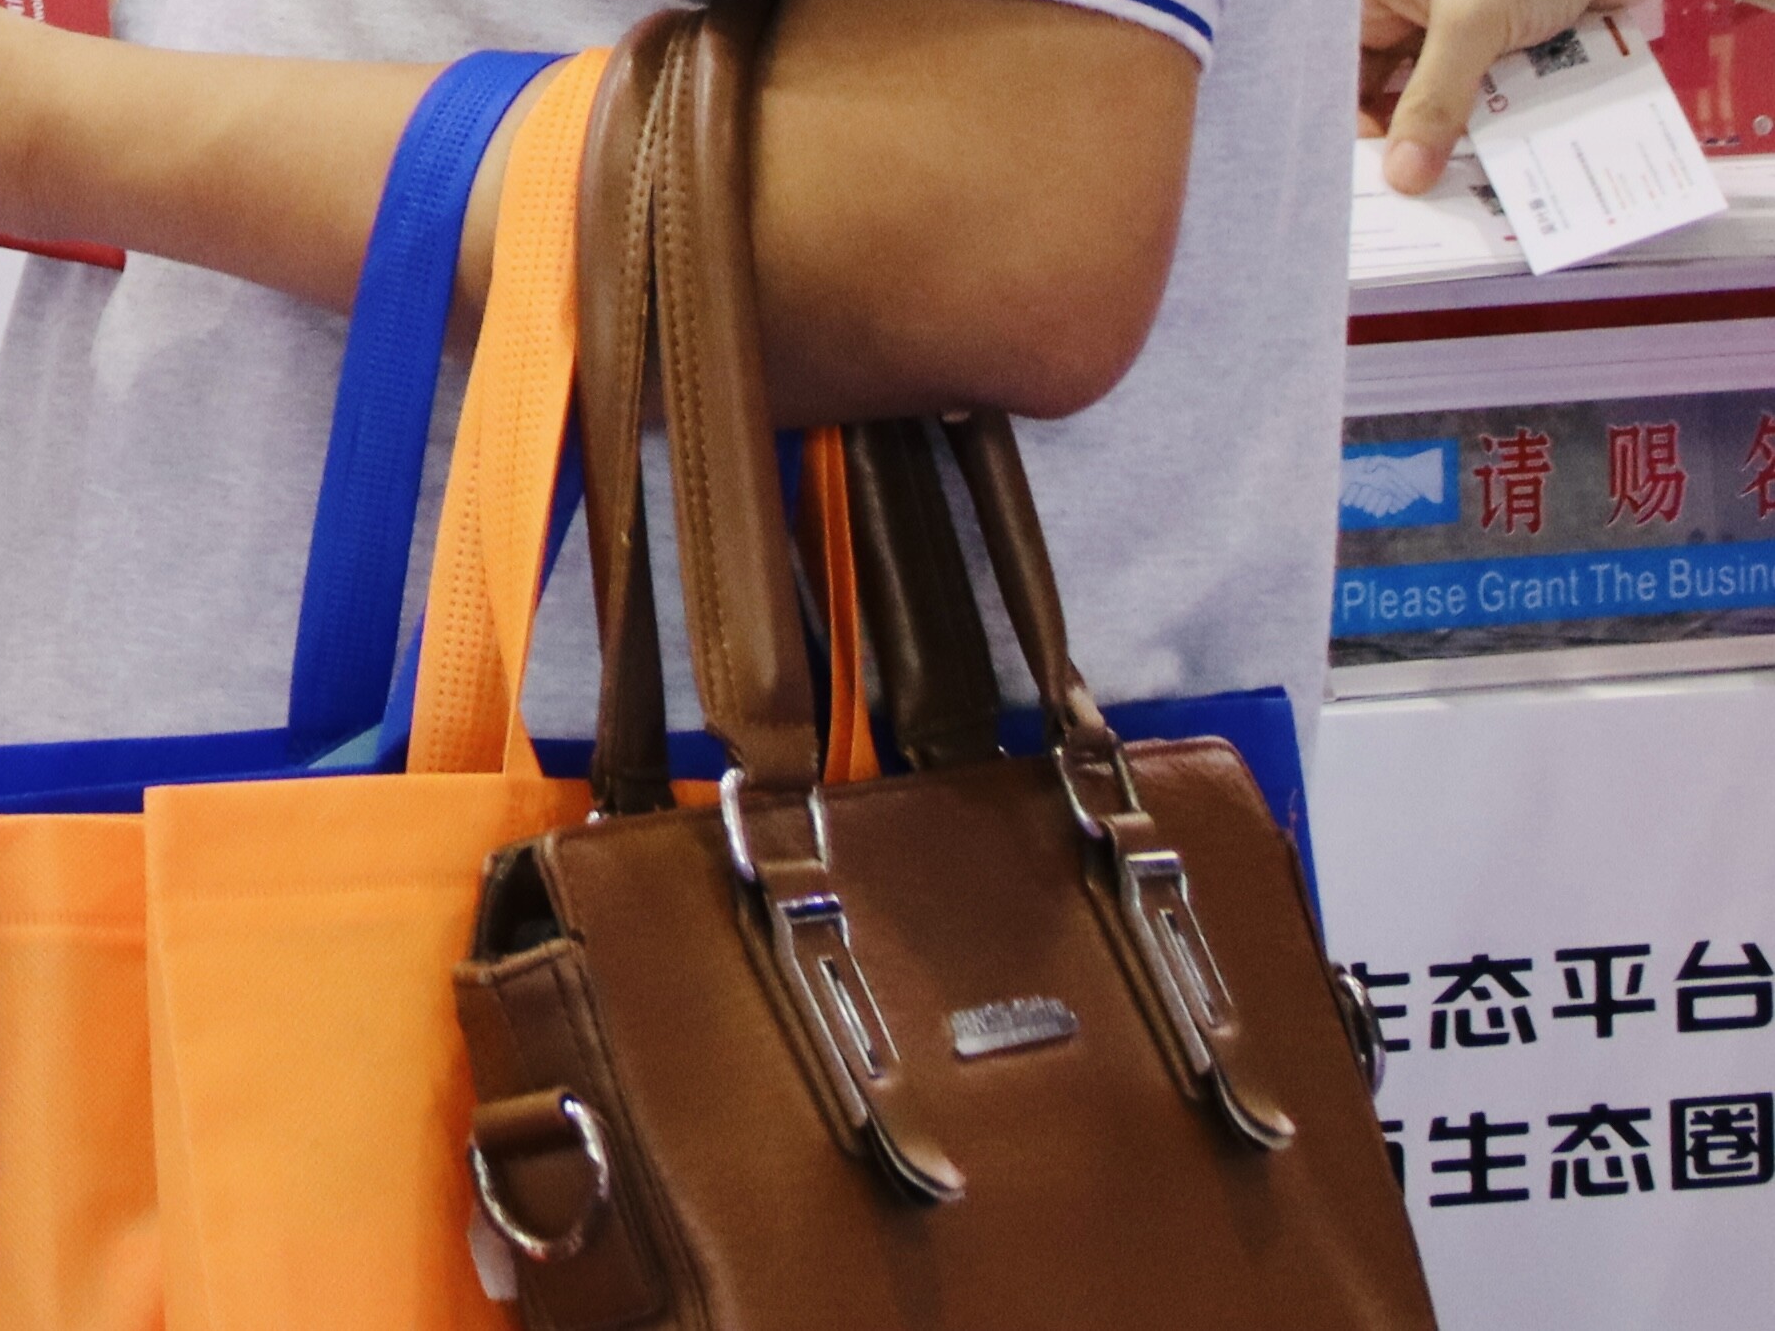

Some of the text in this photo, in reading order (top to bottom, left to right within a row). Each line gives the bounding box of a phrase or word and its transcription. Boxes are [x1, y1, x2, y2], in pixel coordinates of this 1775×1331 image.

[1343, 553, 1775, 623] Please Grant The Busin
[1379, 1092, 1775, 1207] 生态圈
